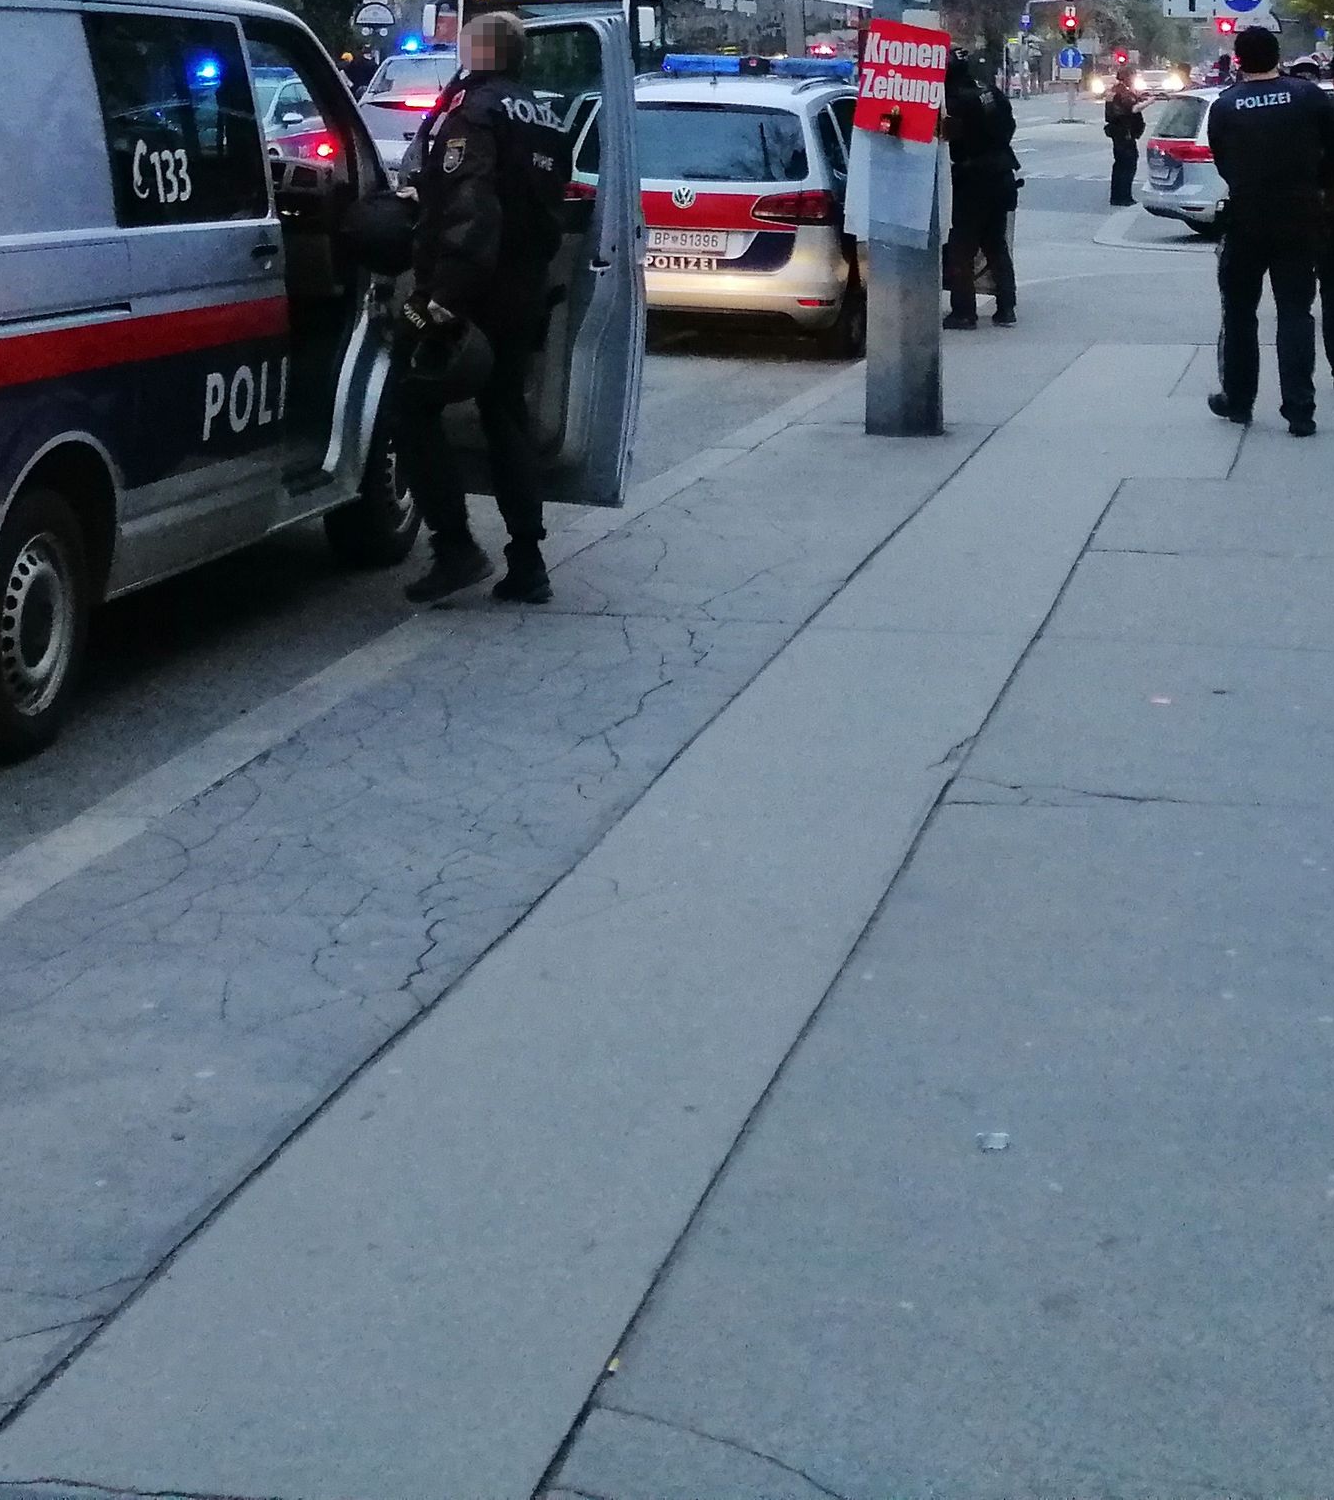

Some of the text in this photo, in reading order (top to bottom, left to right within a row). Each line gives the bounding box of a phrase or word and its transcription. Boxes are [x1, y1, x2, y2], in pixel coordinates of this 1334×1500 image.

[864, 32, 947, 69] Kronen
[860, 68, 945, 110] Zeitung
[1235, 92, 1292, 110] POLIZEI
[654, 232, 719, 248] BP 91396
[645, 256, 717, 271] POLIZEI
[202, 357, 287, 441] POLI
